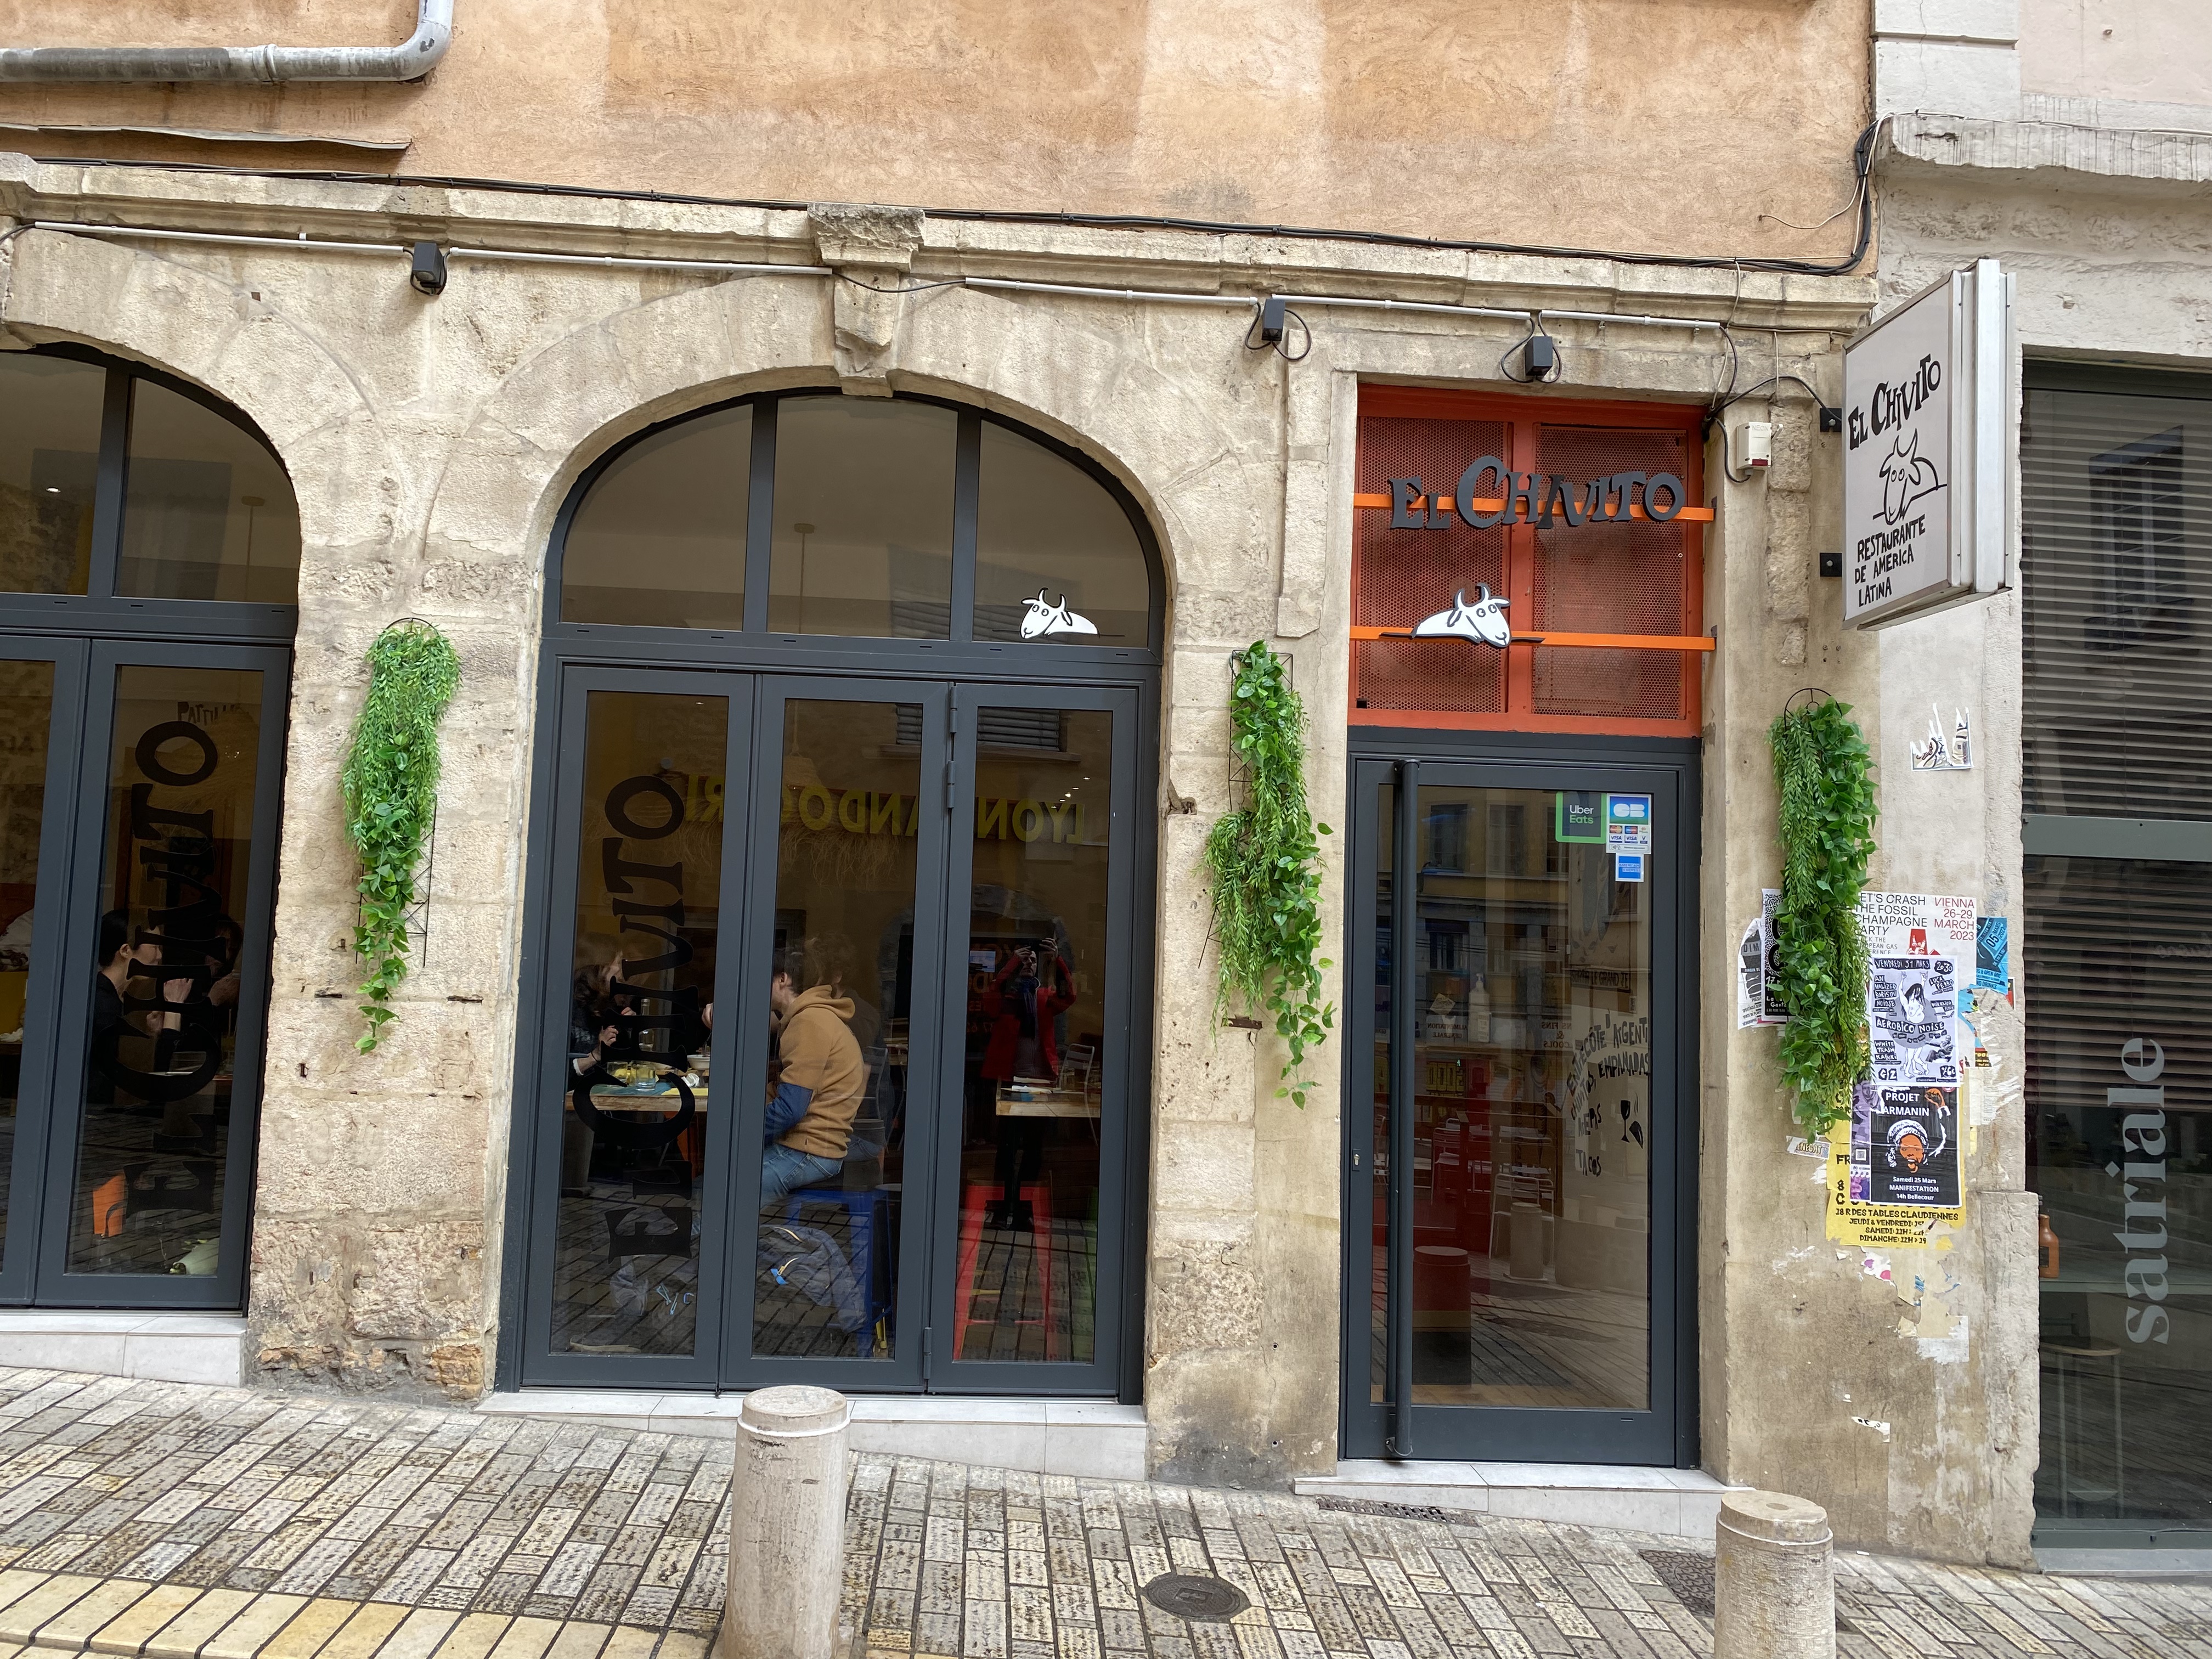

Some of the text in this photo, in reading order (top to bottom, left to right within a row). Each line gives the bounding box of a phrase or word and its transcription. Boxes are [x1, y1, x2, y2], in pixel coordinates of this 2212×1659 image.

[1849, 353, 1941, 451] EL CHIVITO
[1388, 456, 1686, 530] EL CHIVITO
[1857, 514, 1926, 562] RESTAURANTE
[1855, 544, 1914, 585] DE AMERICA
[1858, 576, 1892, 607] LATINA
[1570, 805, 1594, 814] Uber
[1613, 803, 1645, 817] CB
[1570, 815, 1594, 824] Eats
[1860, 893, 1926, 905] ET'S CRASH
[1935, 897, 1974, 909] VIENNA
[1878, 905, 1918, 916] FOSSIL
[1857, 914, 1927, 927] CHAMPAGNE
[1934, 919, 1974, 930] MARCH
[1860, 926, 1889, 935] ARTY
[1993, 922, 2001, 934] MARS
[1998, 927, 2006, 938] 2023
[1950, 930, 1974, 941] 2023
[1985, 934, 1999, 947] 05
[1875, 960, 1903, 968] VENDREDI
[1916, 960, 1930, 968] MARS
[1937, 980, 1954, 989] FERRO
[573, 775, 699, 1265] EL CHIVITO
[1886, 1092, 1920, 1103] PROJET
[1884, 1107, 1929, 1116] ARMANIN
[1798, 1142, 1822, 1154] ENEGAT
[2104, 1037, 2169, 1345] satriale
[1868, 1209, 1899, 1218] TABLES
[1901, 1211, 1959, 1221] CLAUDIENNES
